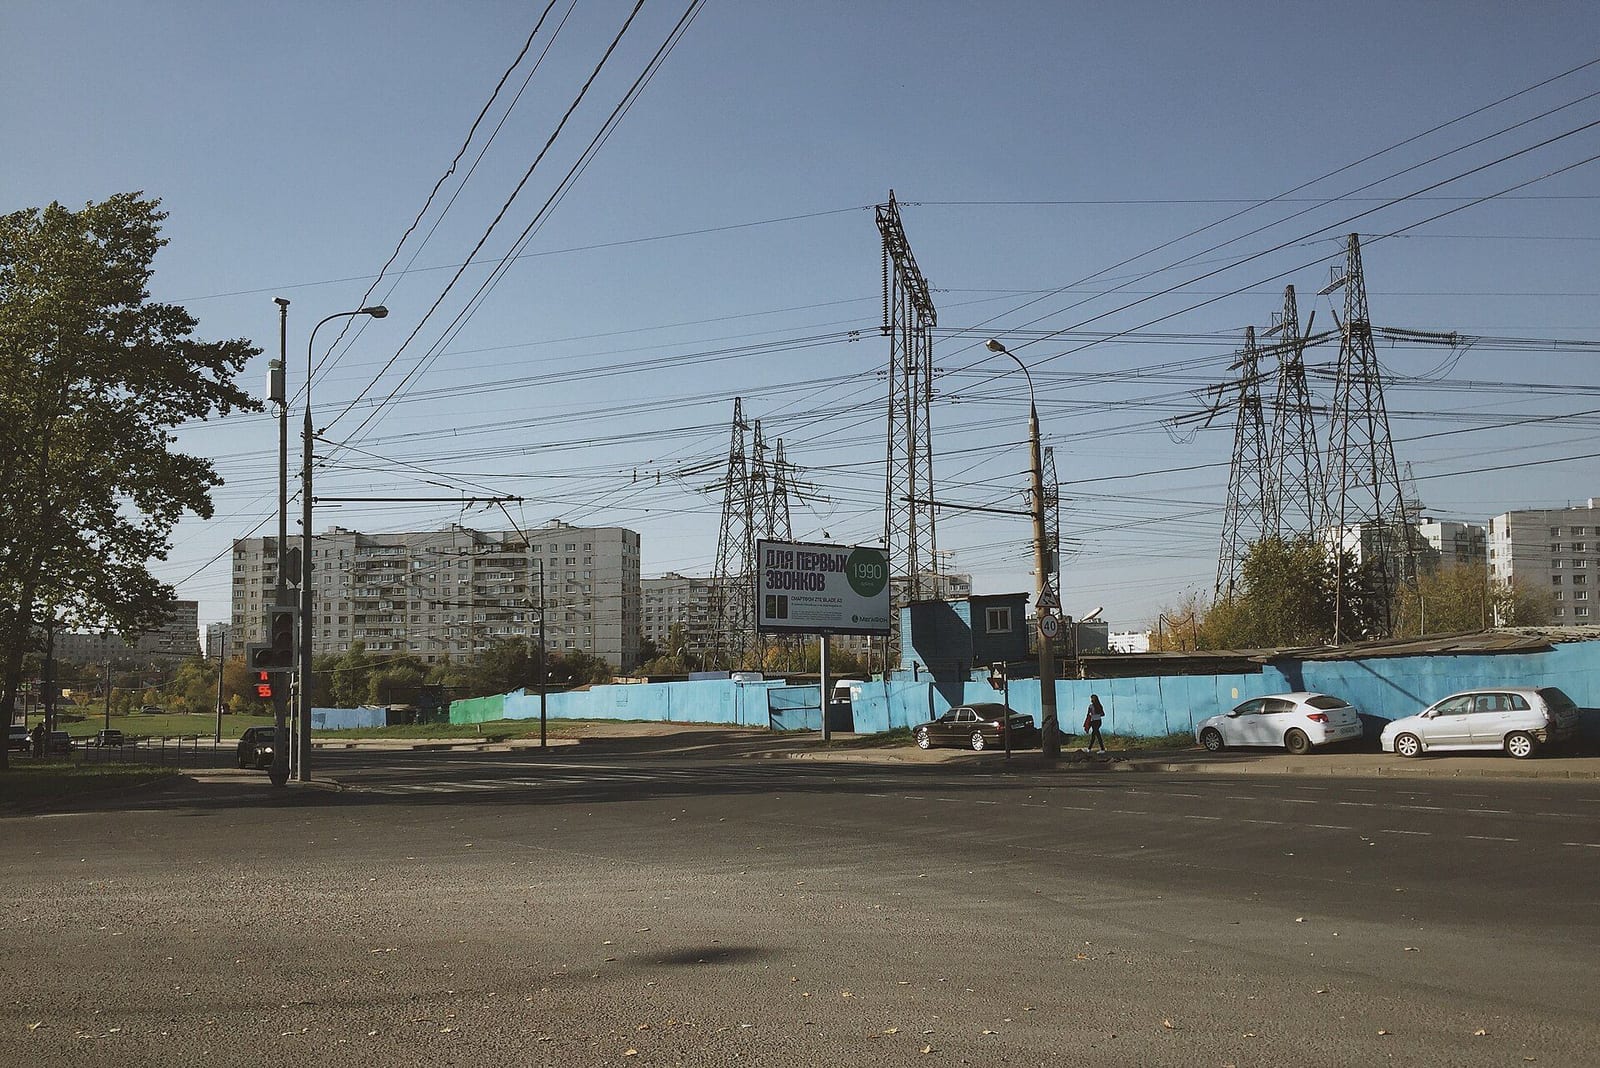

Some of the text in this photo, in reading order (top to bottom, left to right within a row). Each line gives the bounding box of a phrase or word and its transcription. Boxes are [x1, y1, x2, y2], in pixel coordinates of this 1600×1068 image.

[766, 549, 848, 573] ДЛЯ ПЕРВЫХ
[853, 563, 882, 579] 1990
[766, 570, 826, 591] ЗВОНКОВ
[1044, 621, 1056, 631] 40
